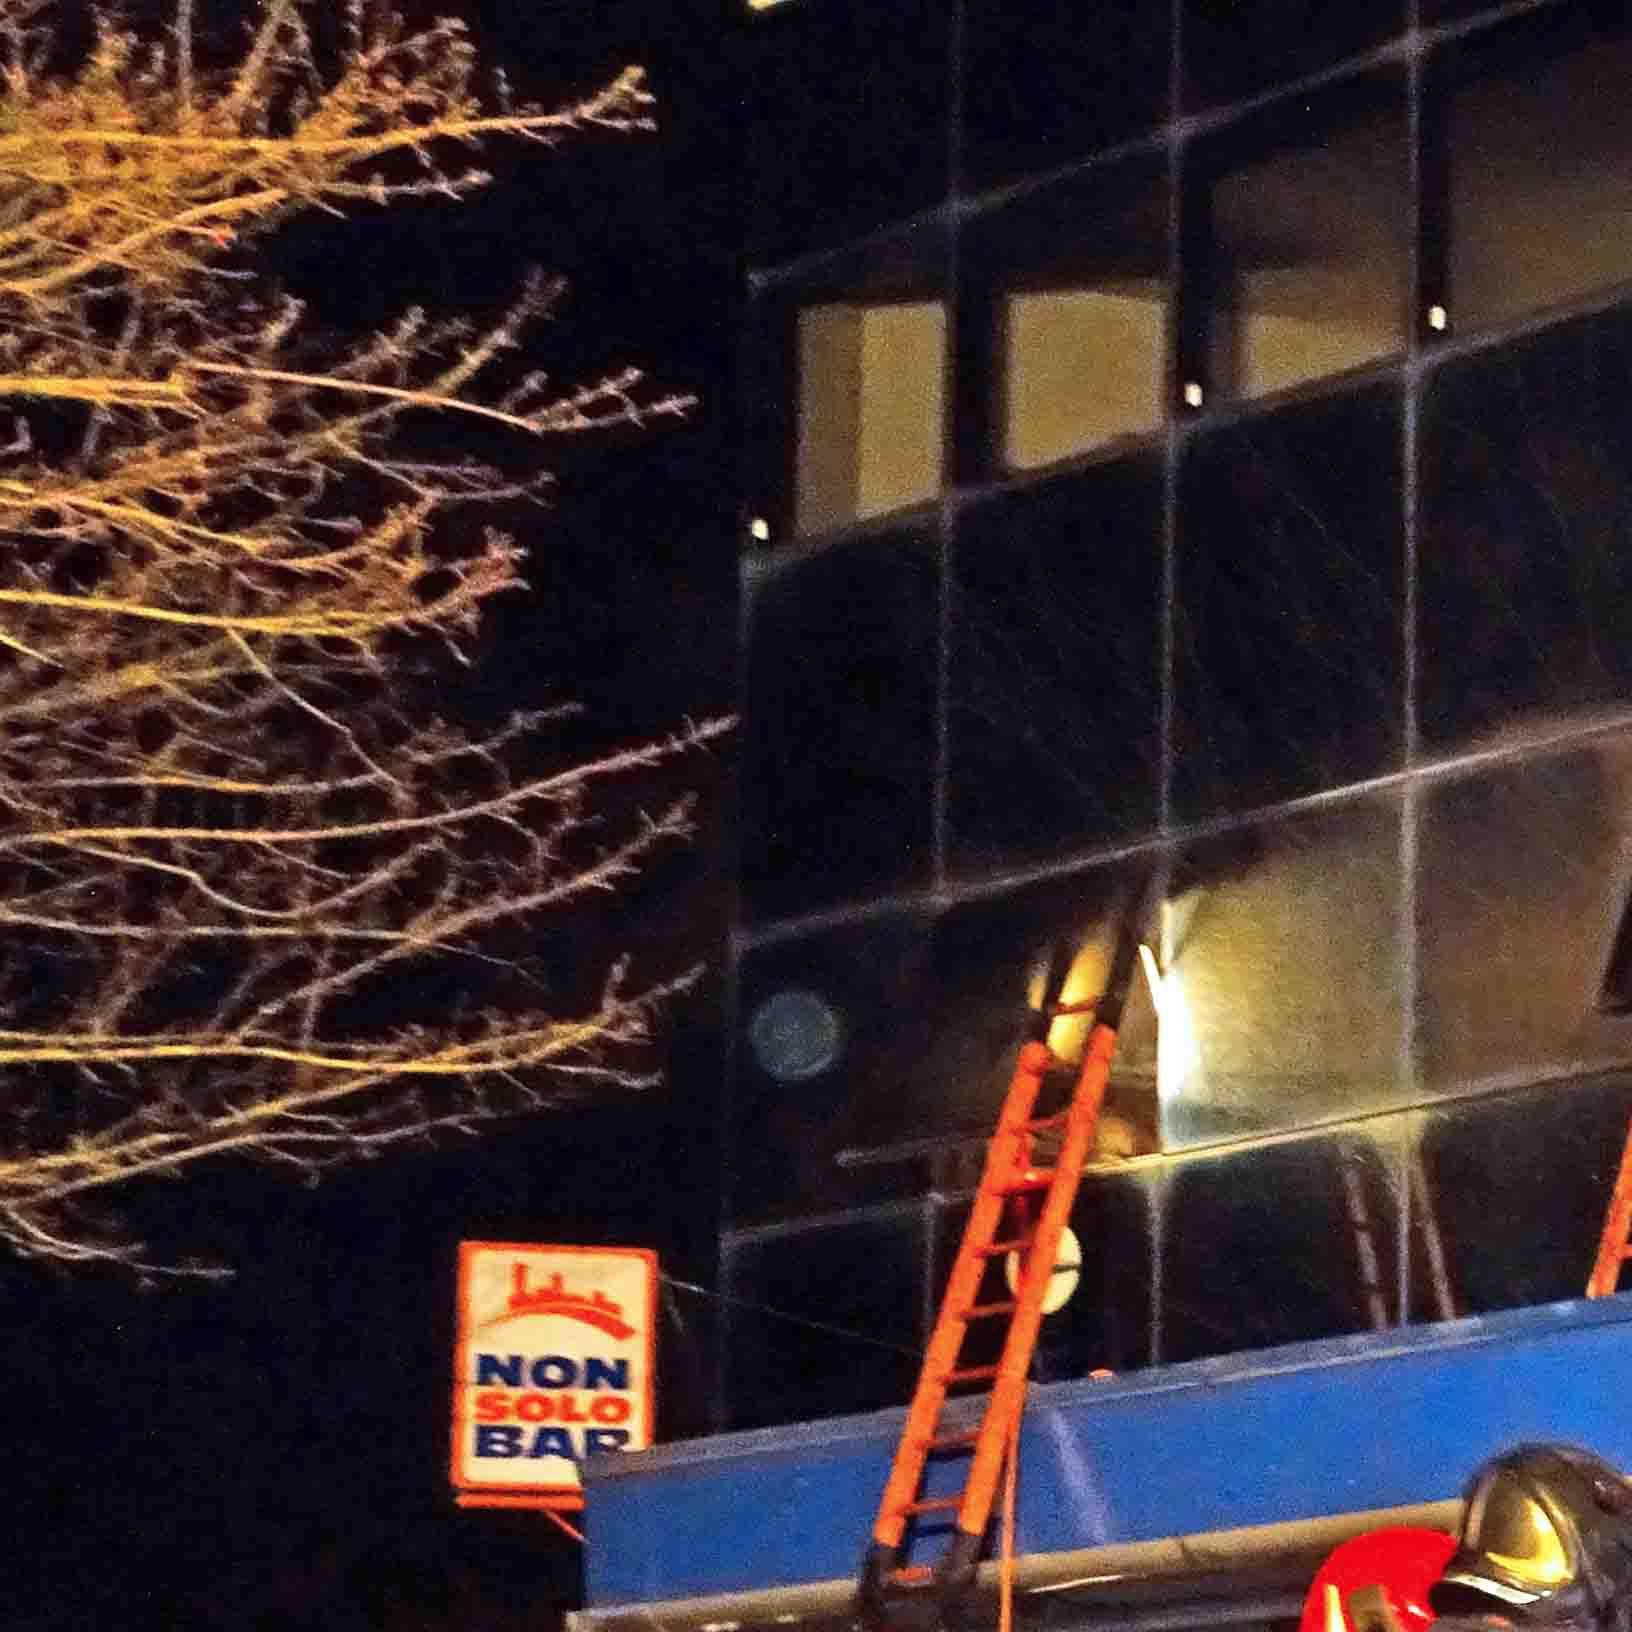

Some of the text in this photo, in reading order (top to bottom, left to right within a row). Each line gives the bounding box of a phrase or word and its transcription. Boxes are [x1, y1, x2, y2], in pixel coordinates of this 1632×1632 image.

[475, 1354, 629, 1389] NON
[475, 1392, 632, 1424] SOLO
[475, 1425, 630, 1459] BAR
